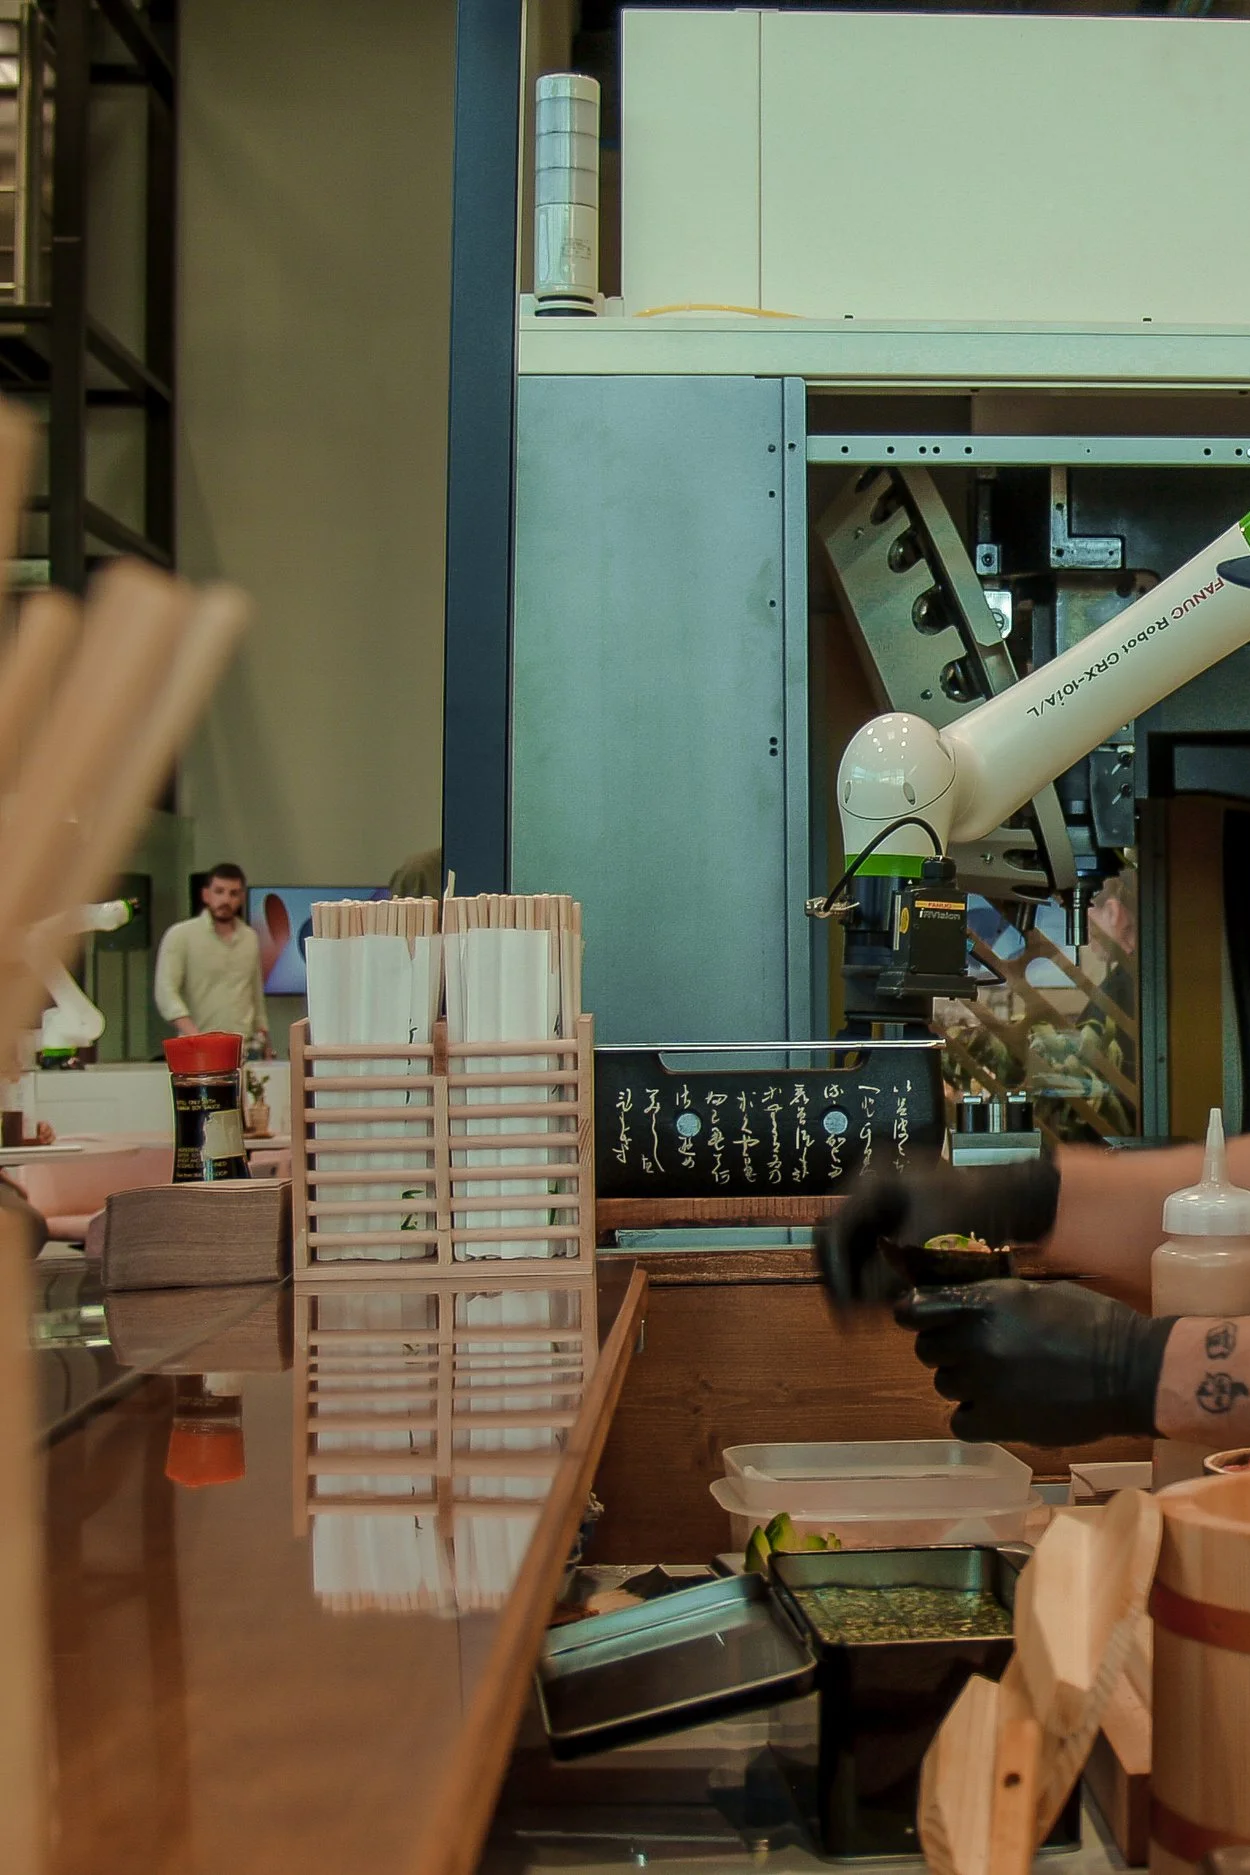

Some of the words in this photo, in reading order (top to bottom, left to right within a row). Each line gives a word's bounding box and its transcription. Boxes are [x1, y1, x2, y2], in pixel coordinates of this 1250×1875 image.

[1170, 577, 1225, 620] FANUC
[1122, 616, 1170, 654] Robot
[1026, 651, 1121, 718] CRX-10iA/L
